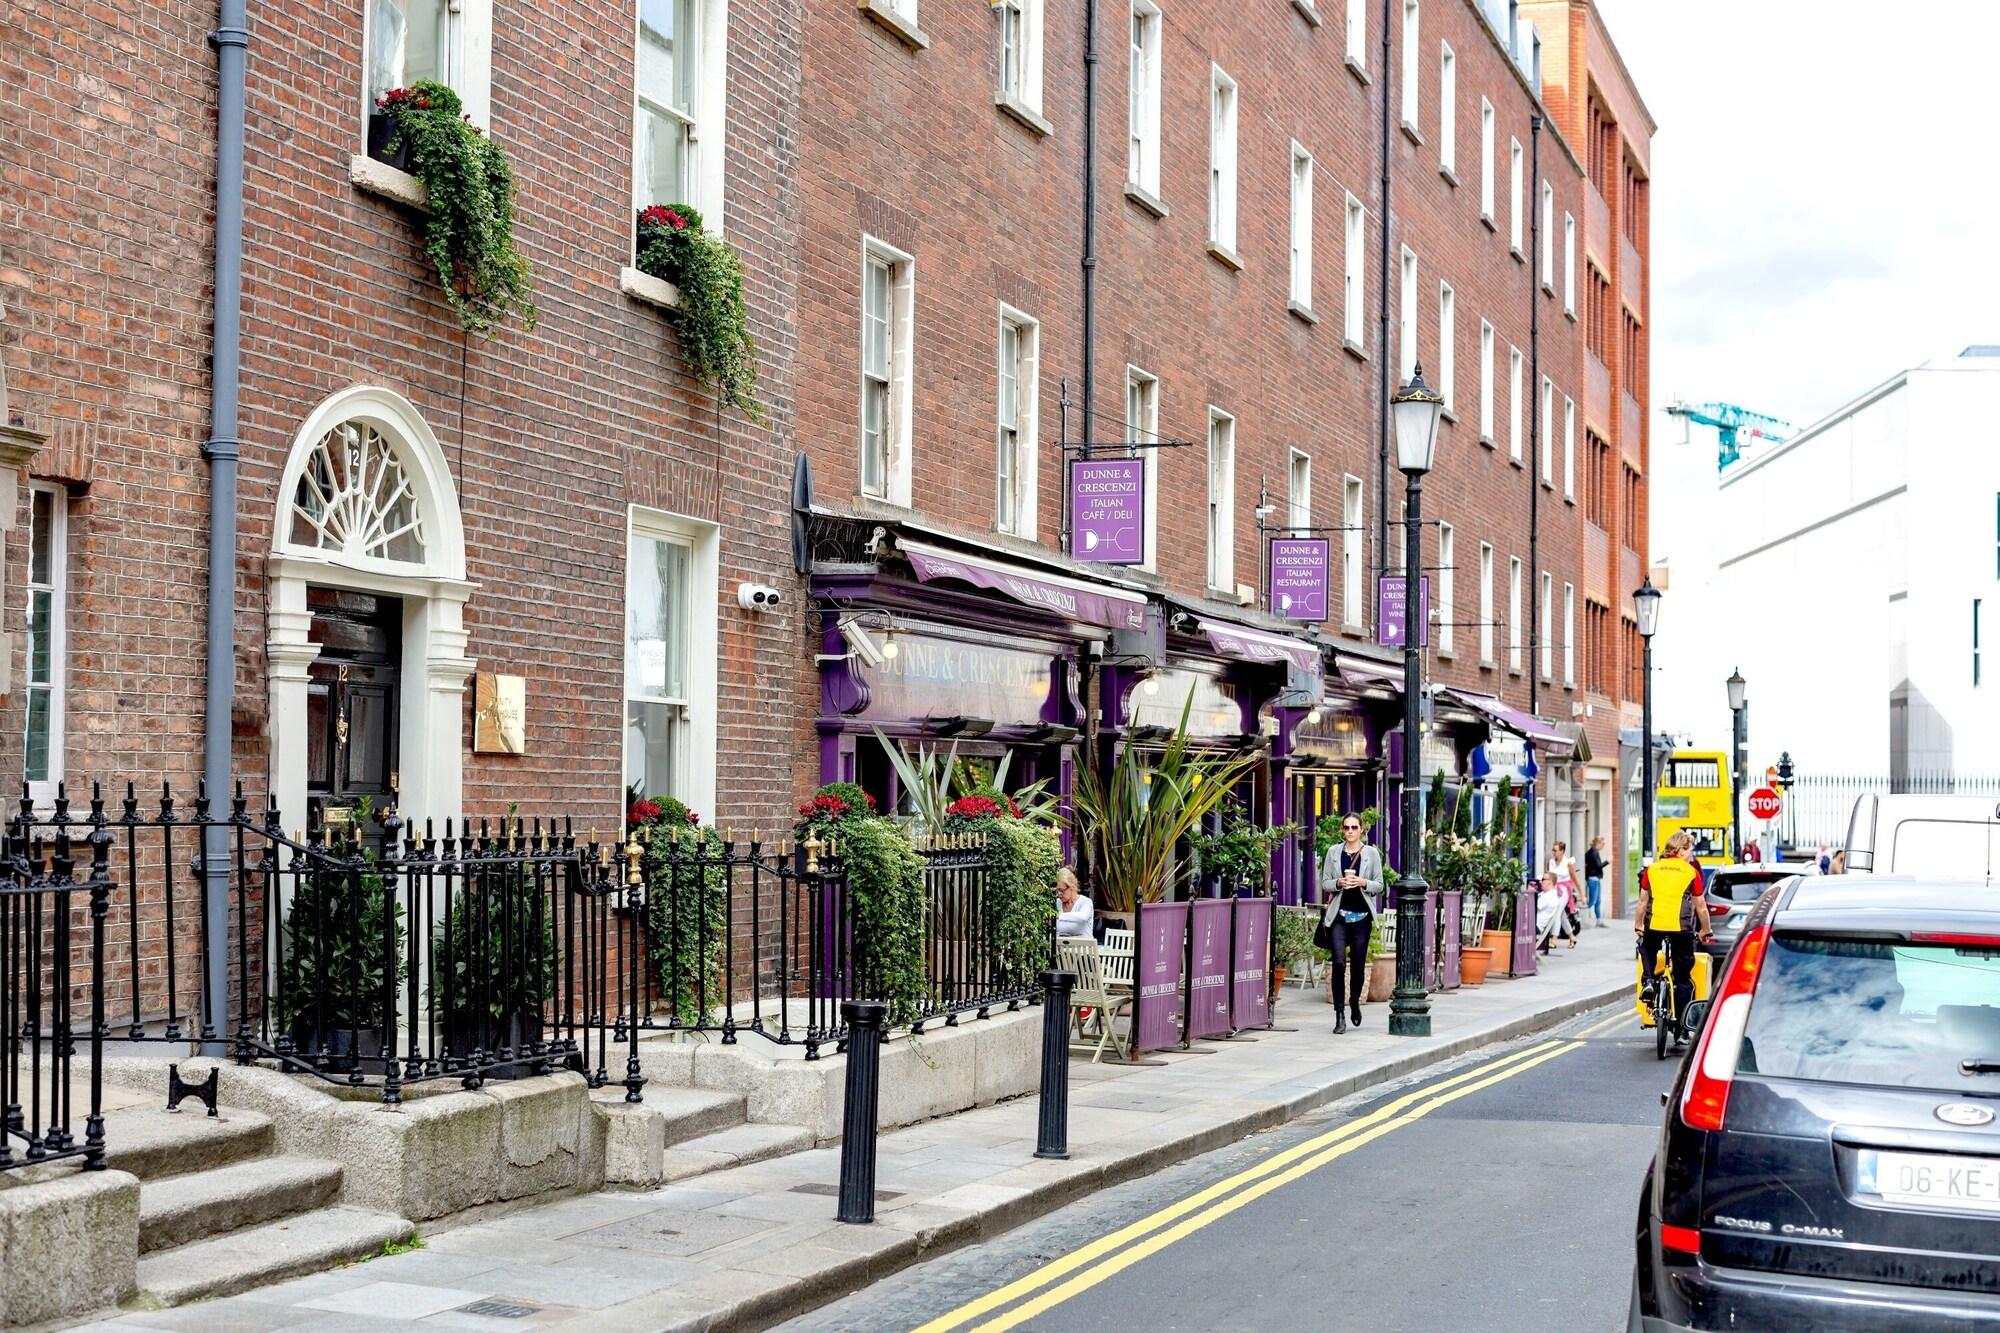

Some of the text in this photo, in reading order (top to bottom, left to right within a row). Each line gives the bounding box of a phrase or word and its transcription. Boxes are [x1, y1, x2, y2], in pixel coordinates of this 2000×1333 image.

[348, 449, 360, 466] 12
[1083, 468, 1131, 480] DUNNE &
[1077, 482, 1137, 493] CRESCENZI
[1091, 498, 1123, 508] ITALIAN
[1114, 510, 1133, 520] DELI
[1280, 546, 1320, 555] DUNNE &
[1276, 557, 1323, 565] CRESCENZI
[1286, 569, 1312, 577] ITALIAN
[1276, 579, 1321, 587] RESTAURANT
[943, 647, 955, 681] &
[338, 664, 348, 681] 12
[1749, 797, 1780, 811] STOP
[1900, 1165, 2000, 1199] 06-KE-
[1714, 1215, 1844, 1239] FOCUS C-MAX
